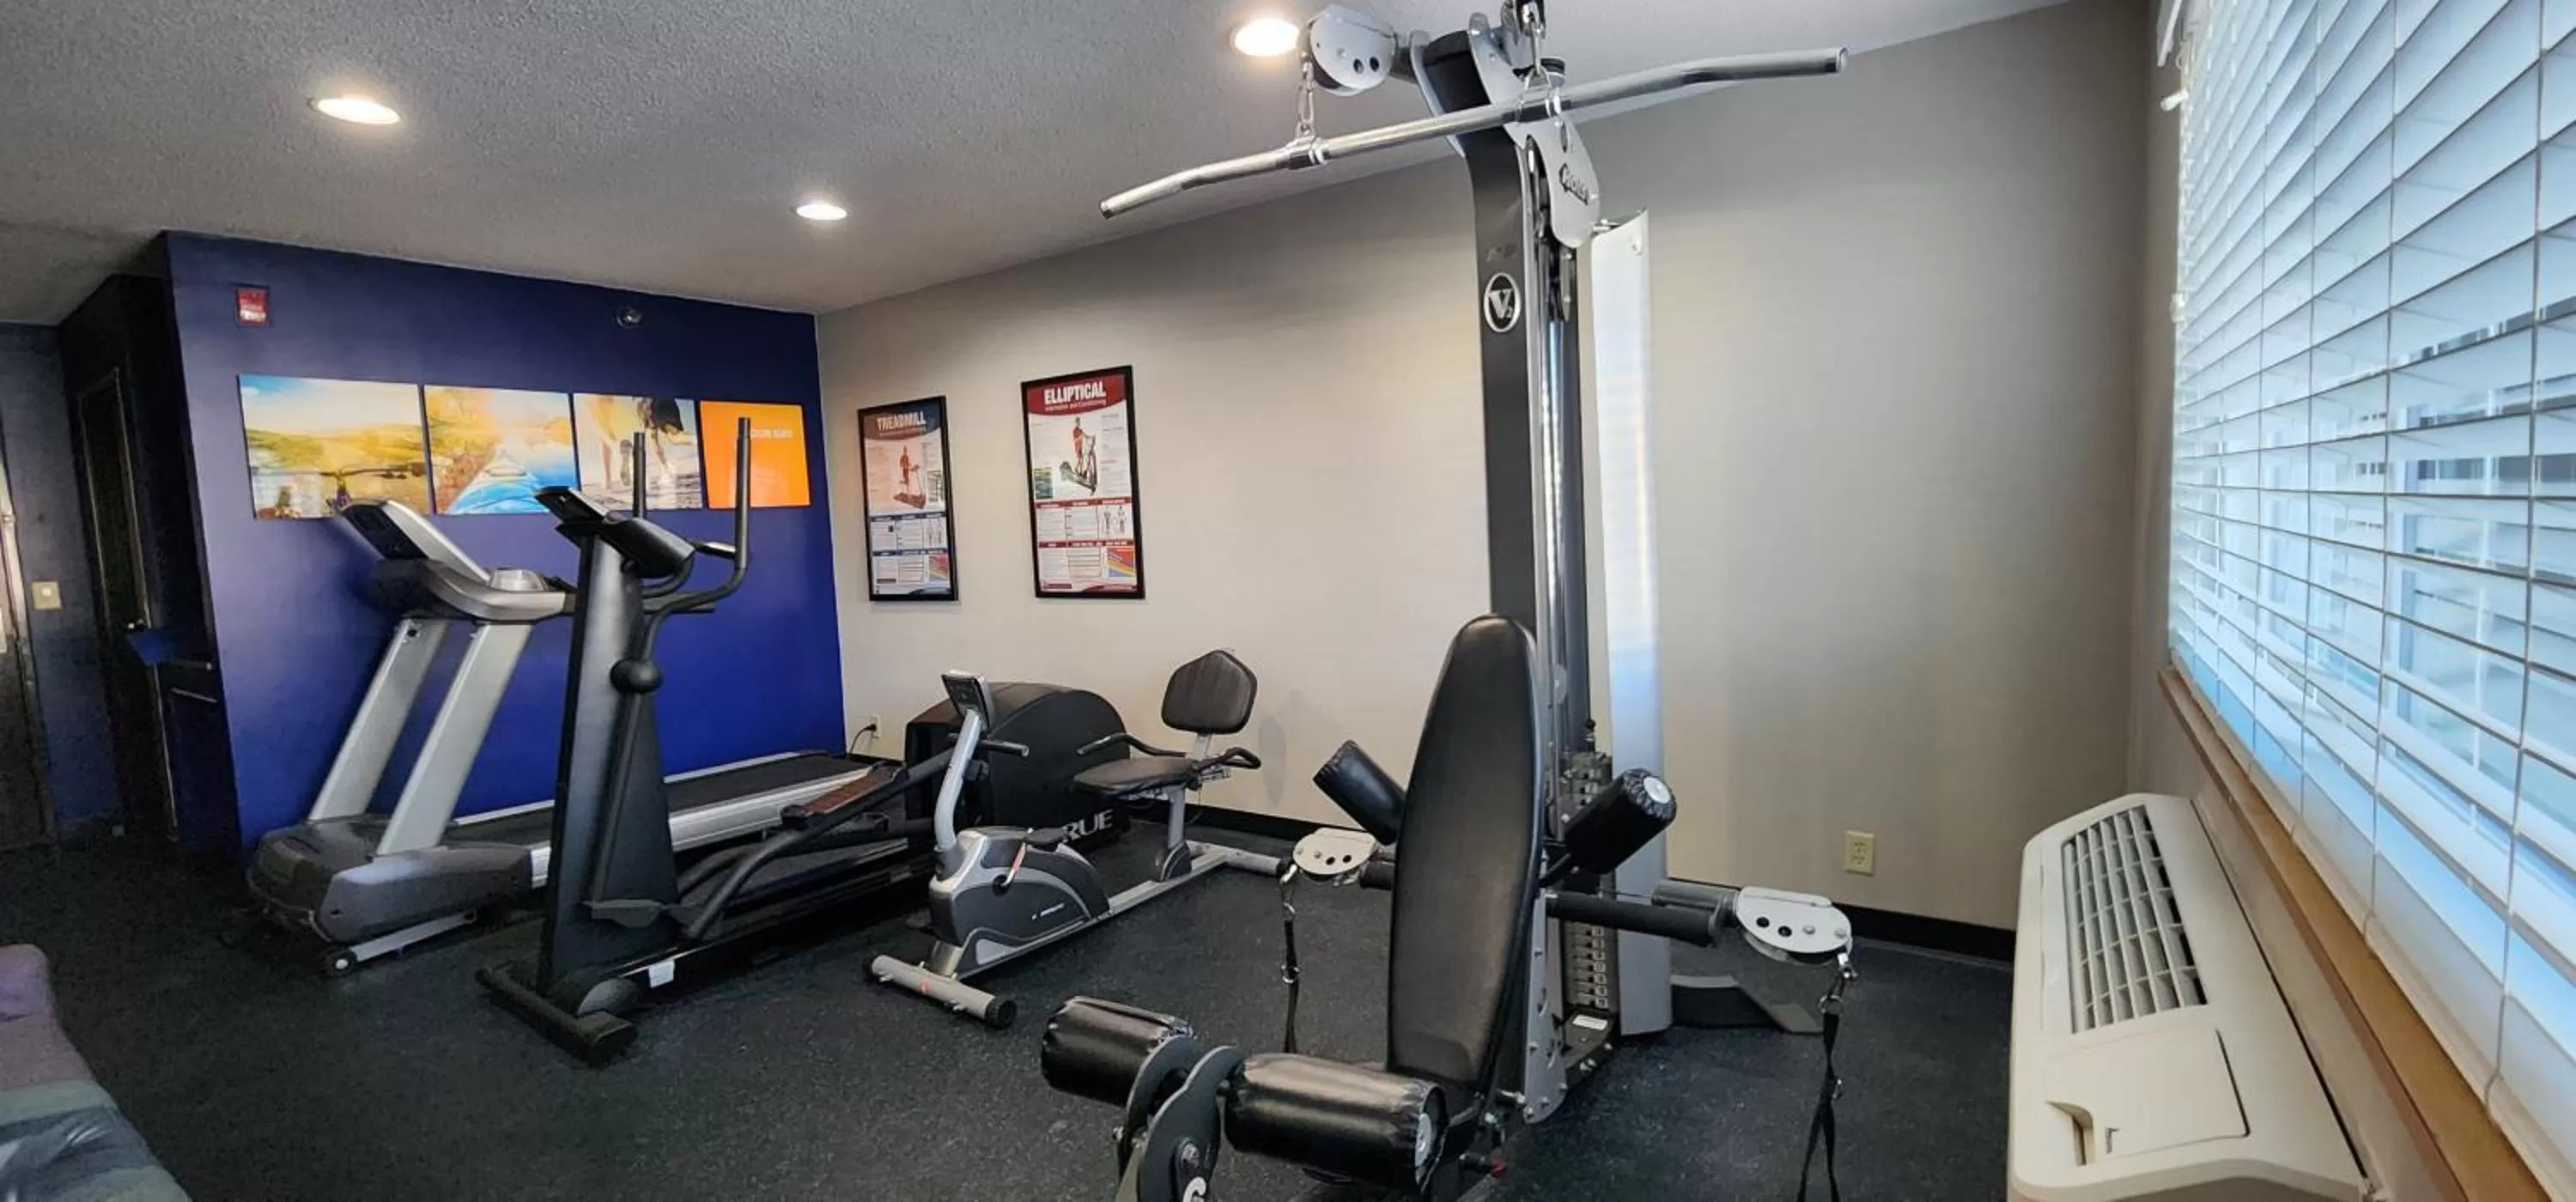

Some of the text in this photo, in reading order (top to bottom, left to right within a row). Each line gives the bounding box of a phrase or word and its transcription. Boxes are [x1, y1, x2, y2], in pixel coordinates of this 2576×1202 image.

[1044, 380, 1106, 405] ELLIPTICAL
[877, 410, 927, 431] TREADMILL
[1062, 809, 1114, 841] RUE
